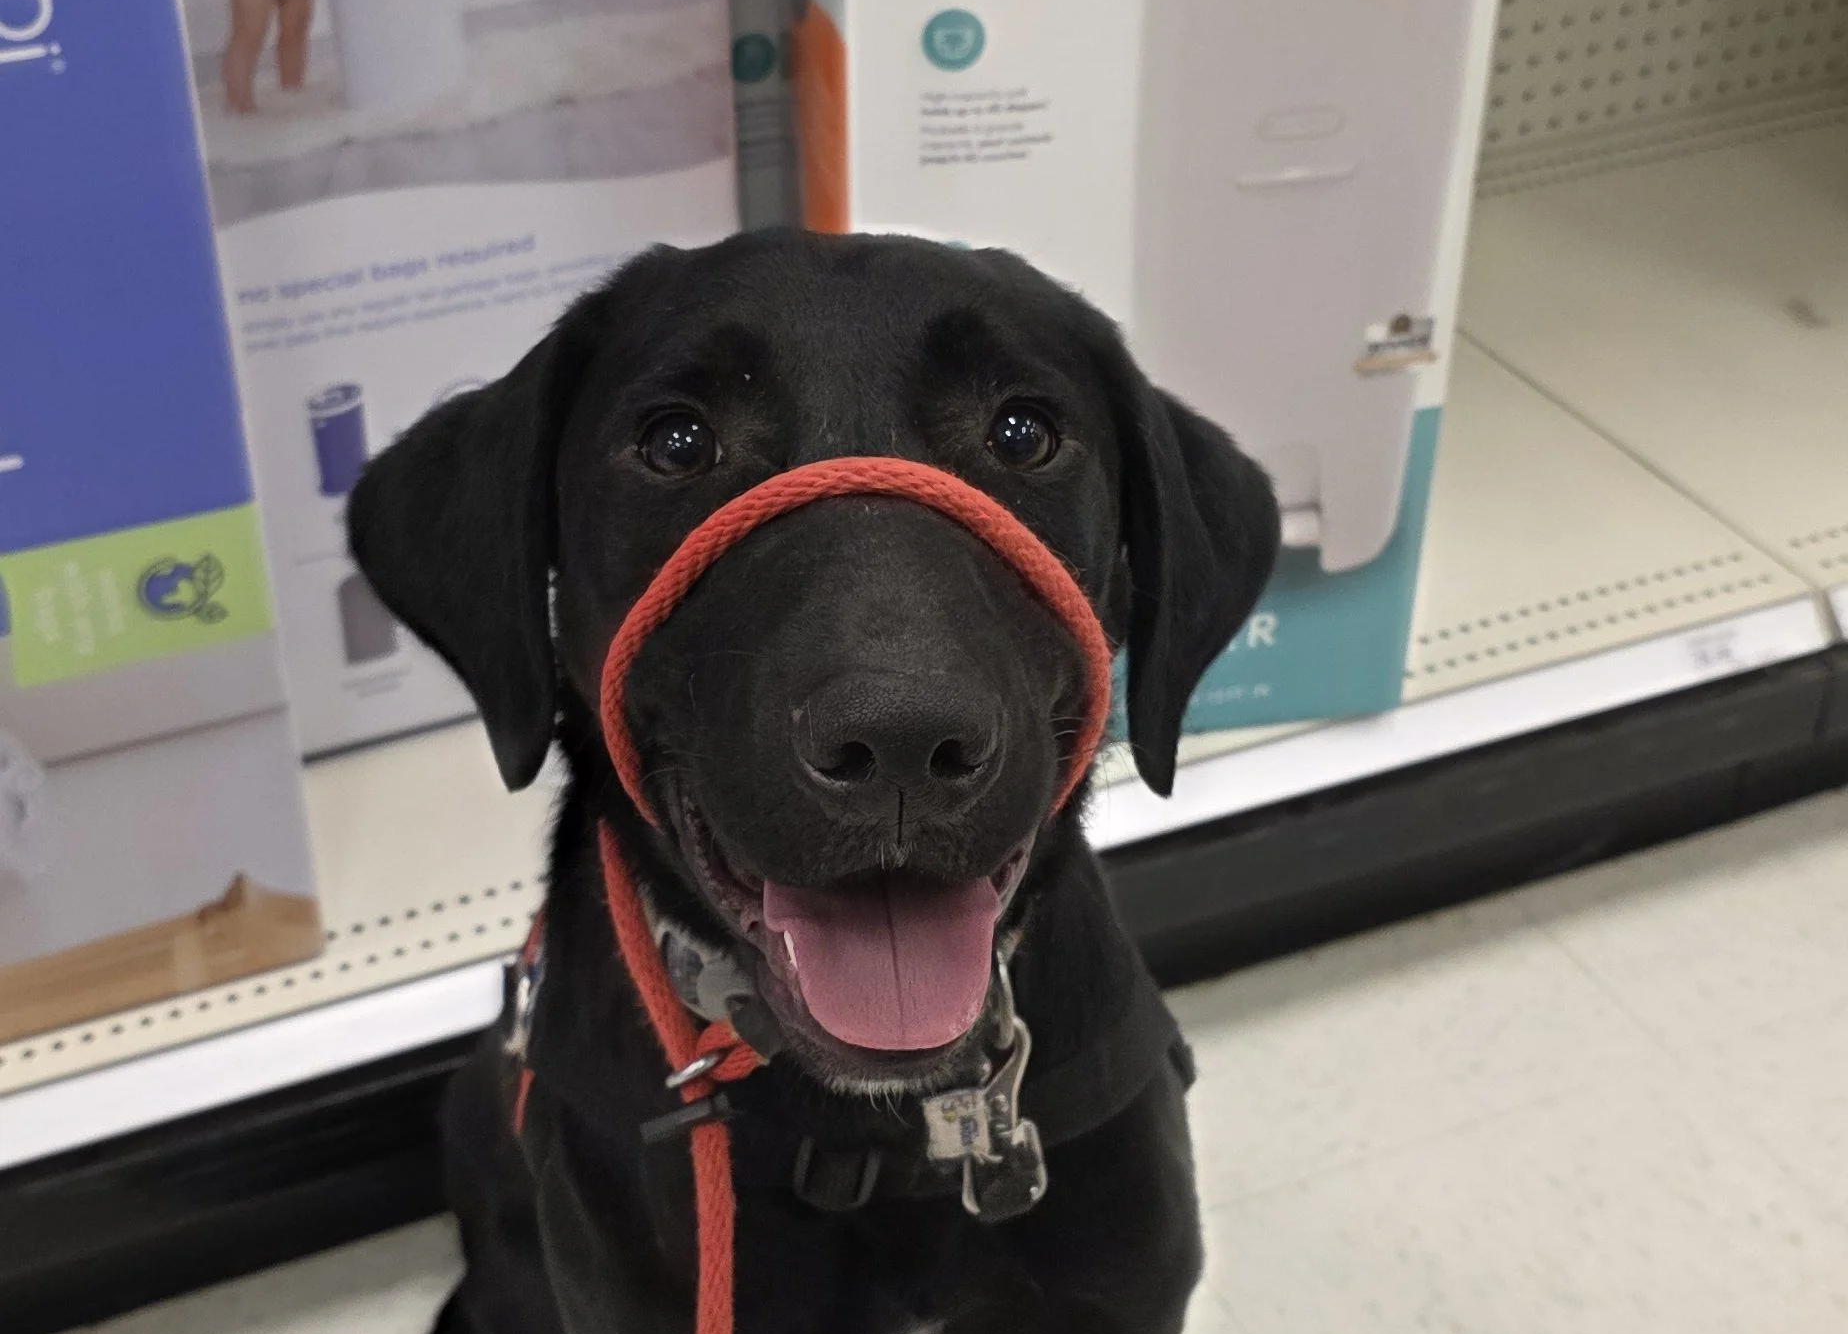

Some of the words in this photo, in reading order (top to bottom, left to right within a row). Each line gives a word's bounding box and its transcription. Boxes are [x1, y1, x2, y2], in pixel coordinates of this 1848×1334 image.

[238, 287, 271, 303] no
[279, 268, 363, 299] special
[371, 256, 428, 282] bags
[437, 233, 535, 265] required
